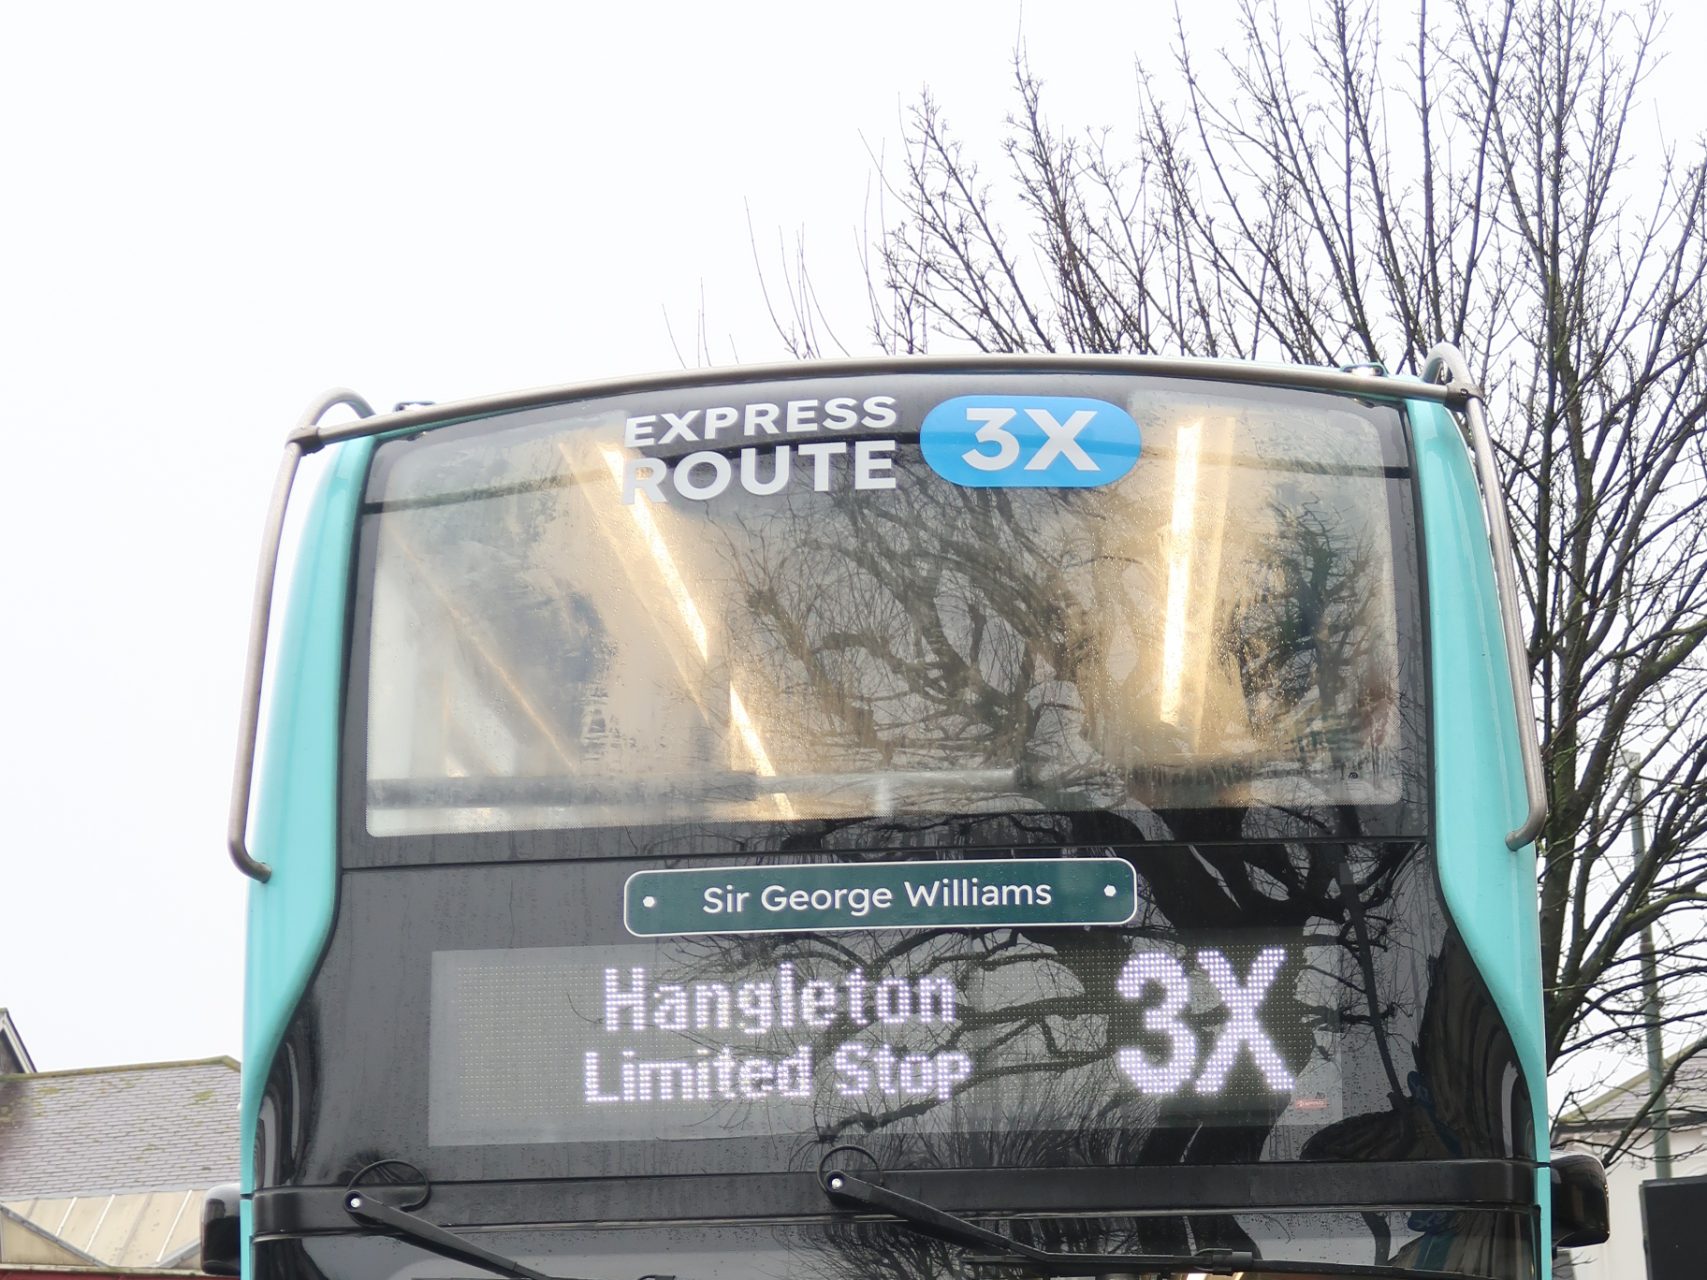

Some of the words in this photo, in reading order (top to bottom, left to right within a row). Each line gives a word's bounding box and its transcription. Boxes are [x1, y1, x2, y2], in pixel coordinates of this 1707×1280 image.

[624, 396, 898, 448] EXPRESS
[961, 407, 1101, 472] 3X
[621, 440, 897, 506] ROUTE
[703, 884, 749, 913] Sir
[761, 885, 893, 916] George
[904, 877, 1052, 908] Williams
[605, 963, 955, 1033] Hangleton
[1117, 948, 1295, 1095] 3X
[584, 1044, 812, 1102] Limited
[835, 1043, 971, 1099] Stop
